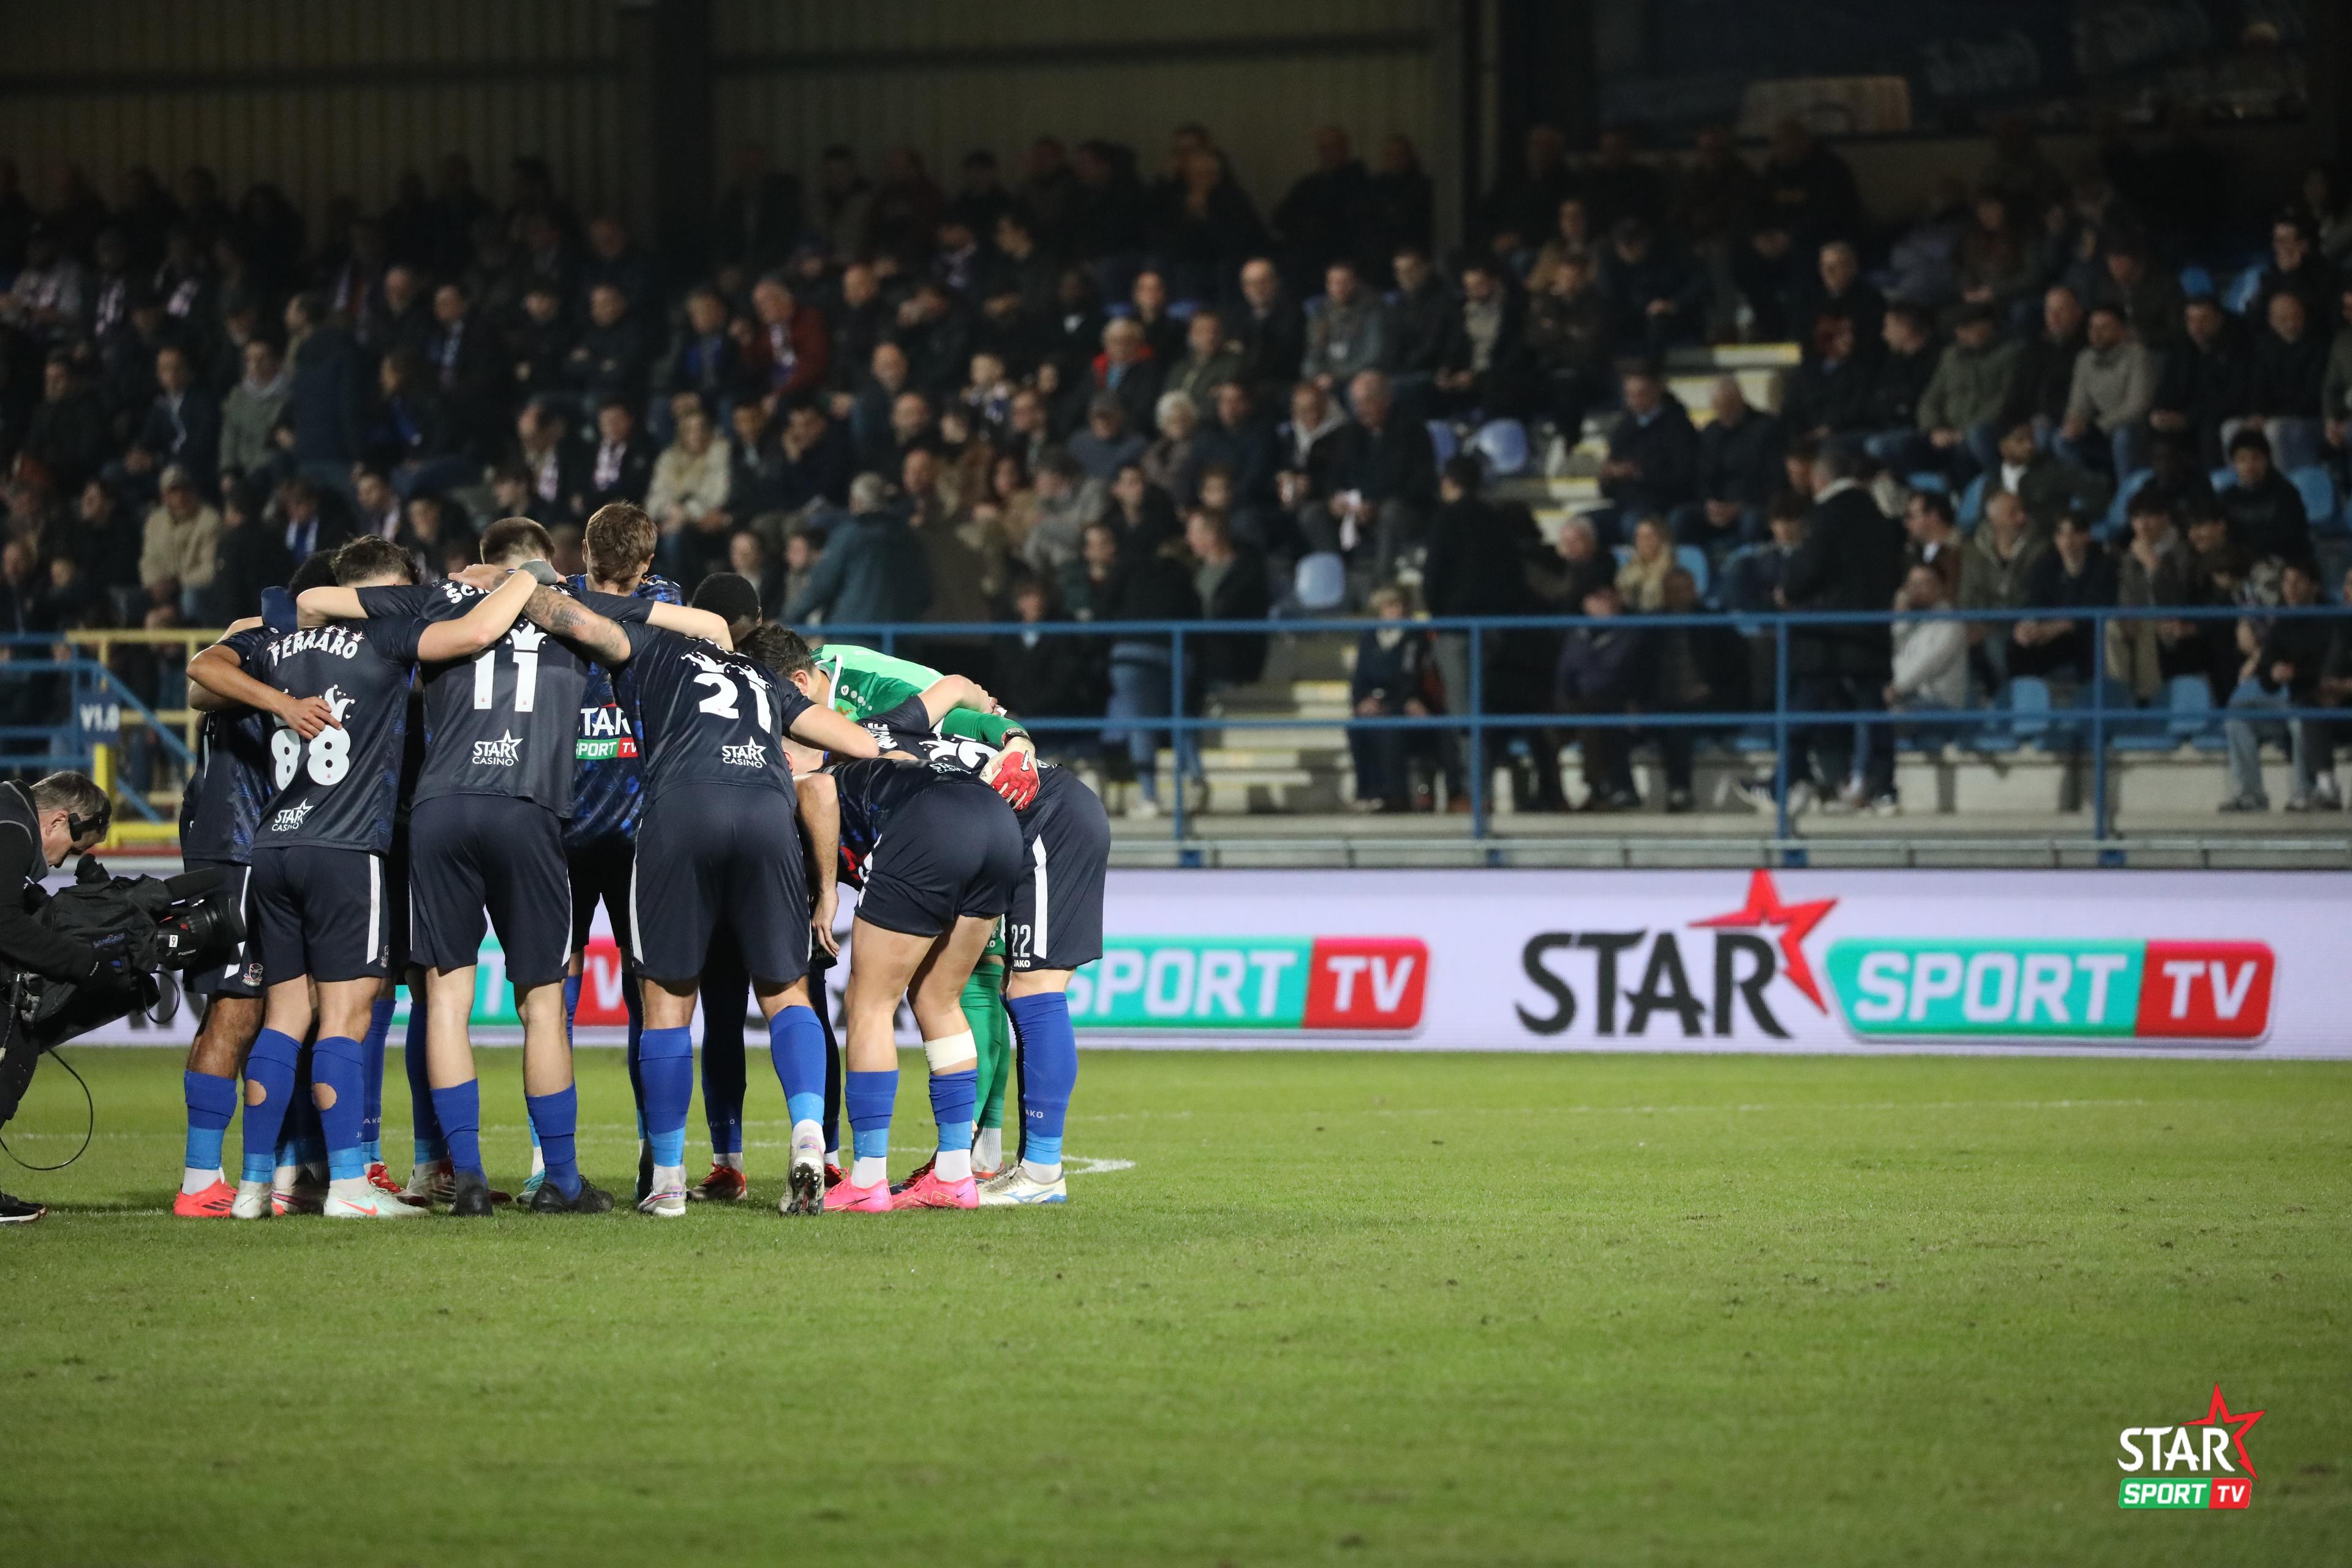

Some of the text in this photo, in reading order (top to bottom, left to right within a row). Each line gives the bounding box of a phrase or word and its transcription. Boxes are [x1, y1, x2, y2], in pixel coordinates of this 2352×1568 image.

[270, 632, 358, 666] FERRARO
[472, 649, 538, 712] 11
[693, 672, 772, 734] 21
[578, 706, 632, 736] TAR
[271, 724, 351, 791] 88
[472, 756, 514, 767] CASINO
[473, 740, 514, 759] STAR
[722, 745, 761, 762] STAR
[723, 756, 763, 769] CASINO
[271, 822, 300, 832] CASINO
[275, 807, 304, 825] STAR
[1011, 924, 1031, 957] 22
[1014, 959, 1031, 968] JAKO
[1327, 955, 1415, 1013] TV
[1515, 928, 2259, 1039] STAR SPORT TV
[1025, 1107, 1044, 1118] AKO
